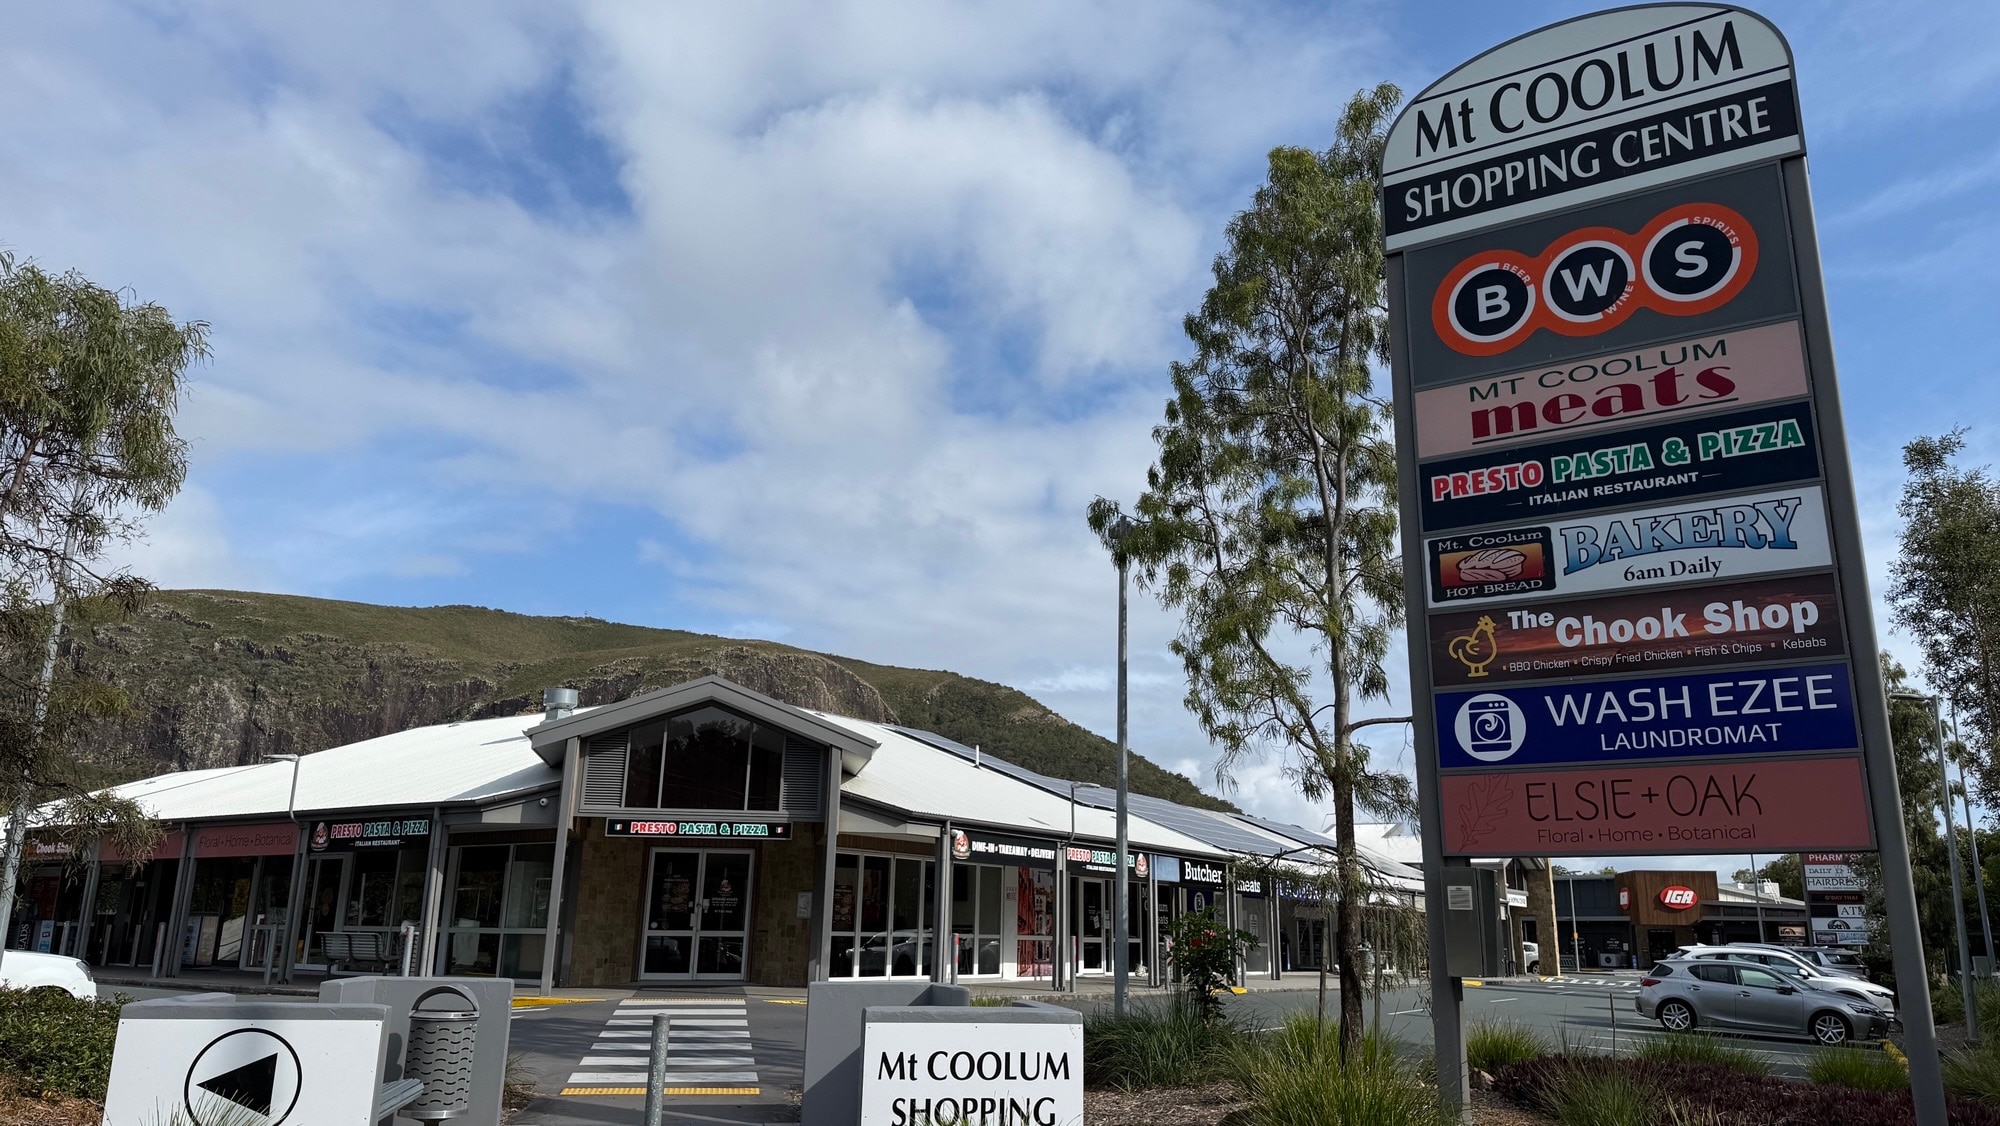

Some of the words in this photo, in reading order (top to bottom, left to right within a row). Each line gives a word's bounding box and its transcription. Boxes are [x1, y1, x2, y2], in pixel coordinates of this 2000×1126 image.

[1415, 98, 1477, 158] Mt
[1489, 20, 1743, 134] COOLUM
[1405, 141, 1600, 222] SHOPPING
[1612, 96, 1771, 168] CENTRE
[1693, 216, 1739, 245] SPIRITS
[1502, 263, 1531, 284] BEER
[1604, 284, 1634, 315] WINE
[1469, 376, 1525, 402] MT
[1537, 339, 1728, 388] COOLUM
[1471, 365, 1736, 439] meats
[1431, 460, 1544, 502] PRESTO
[1551, 442, 1655, 484] PASTA
[1661, 437, 1691, 466] &
[1697, 418, 1805, 461] PIZZA
[1529, 487, 1589, 506] ITALIAN
[1593, 471, 1699, 496] RESTAURANT
[1438, 541, 1464, 552] Mt.
[1469, 530, 1544, 547] Coolum
[1560, 496, 1802, 576] BAKERY
[1623, 563, 1666, 582] 6am
[1668, 555, 1723, 578] Daily
[1446, 585, 1479, 598] HOT
[1484, 579, 1543, 594] BREAD
[1507, 610, 1555, 630] The
[1556, 607, 1690, 648] Chook
[1703, 600, 1819, 634] Shop
[1509, 662, 1531, 672] BBQ
[1533, 658, 1570, 670] Chicken
[1581, 655, 1613, 667] Crispy
[1615, 652, 1641, 664] Fried
[1644, 648, 1683, 661] Chicken
[1694, 646, 1717, 657] Fish
[1721, 644, 1730, 655] &
[1732, 641, 1763, 655] Chips
[1783, 637, 1827, 650] Kebabs
[1544, 685, 1692, 727] WASH
[1708, 674, 1838, 716] EZEE
[1600, 722, 1782, 751] LAUNDROMAT
[199, 835, 221, 849] Floral
[225, 834, 249, 848] Home
[254, 832, 294, 847] Botanical
[330, 823, 363, 838] PRESTO
[363, 821, 392, 837] PASTA
[392, 821, 401, 836] &
[402, 820, 429, 835] PIZZA
[630, 821, 677, 835] PRESTO
[679, 822, 717, 835] PASTA
[720, 823, 730, 835] &
[732, 823, 769, 836] PIZZA
[1537, 828, 1584, 843] Floral
[1598, 827, 1653, 842] Home
[1668, 823, 1756, 841] Botanical
[971, 840, 995, 853] DINE-IN
[998, 844, 1028, 856] TAKEAWAY
[1030, 847, 1055, 860] DELIVERY
[1067, 847, 1091, 862] PRESTO
[1092, 850, 1111, 865] PASTA
[1184, 861, 1223, 884] Butcher
[1664, 889, 1694, 904] IGA
[878, 1051, 918, 1081] Mt
[927, 1050, 1071, 1081] COOLUM
[891, 1096, 1056, 1126] SHOPPING
